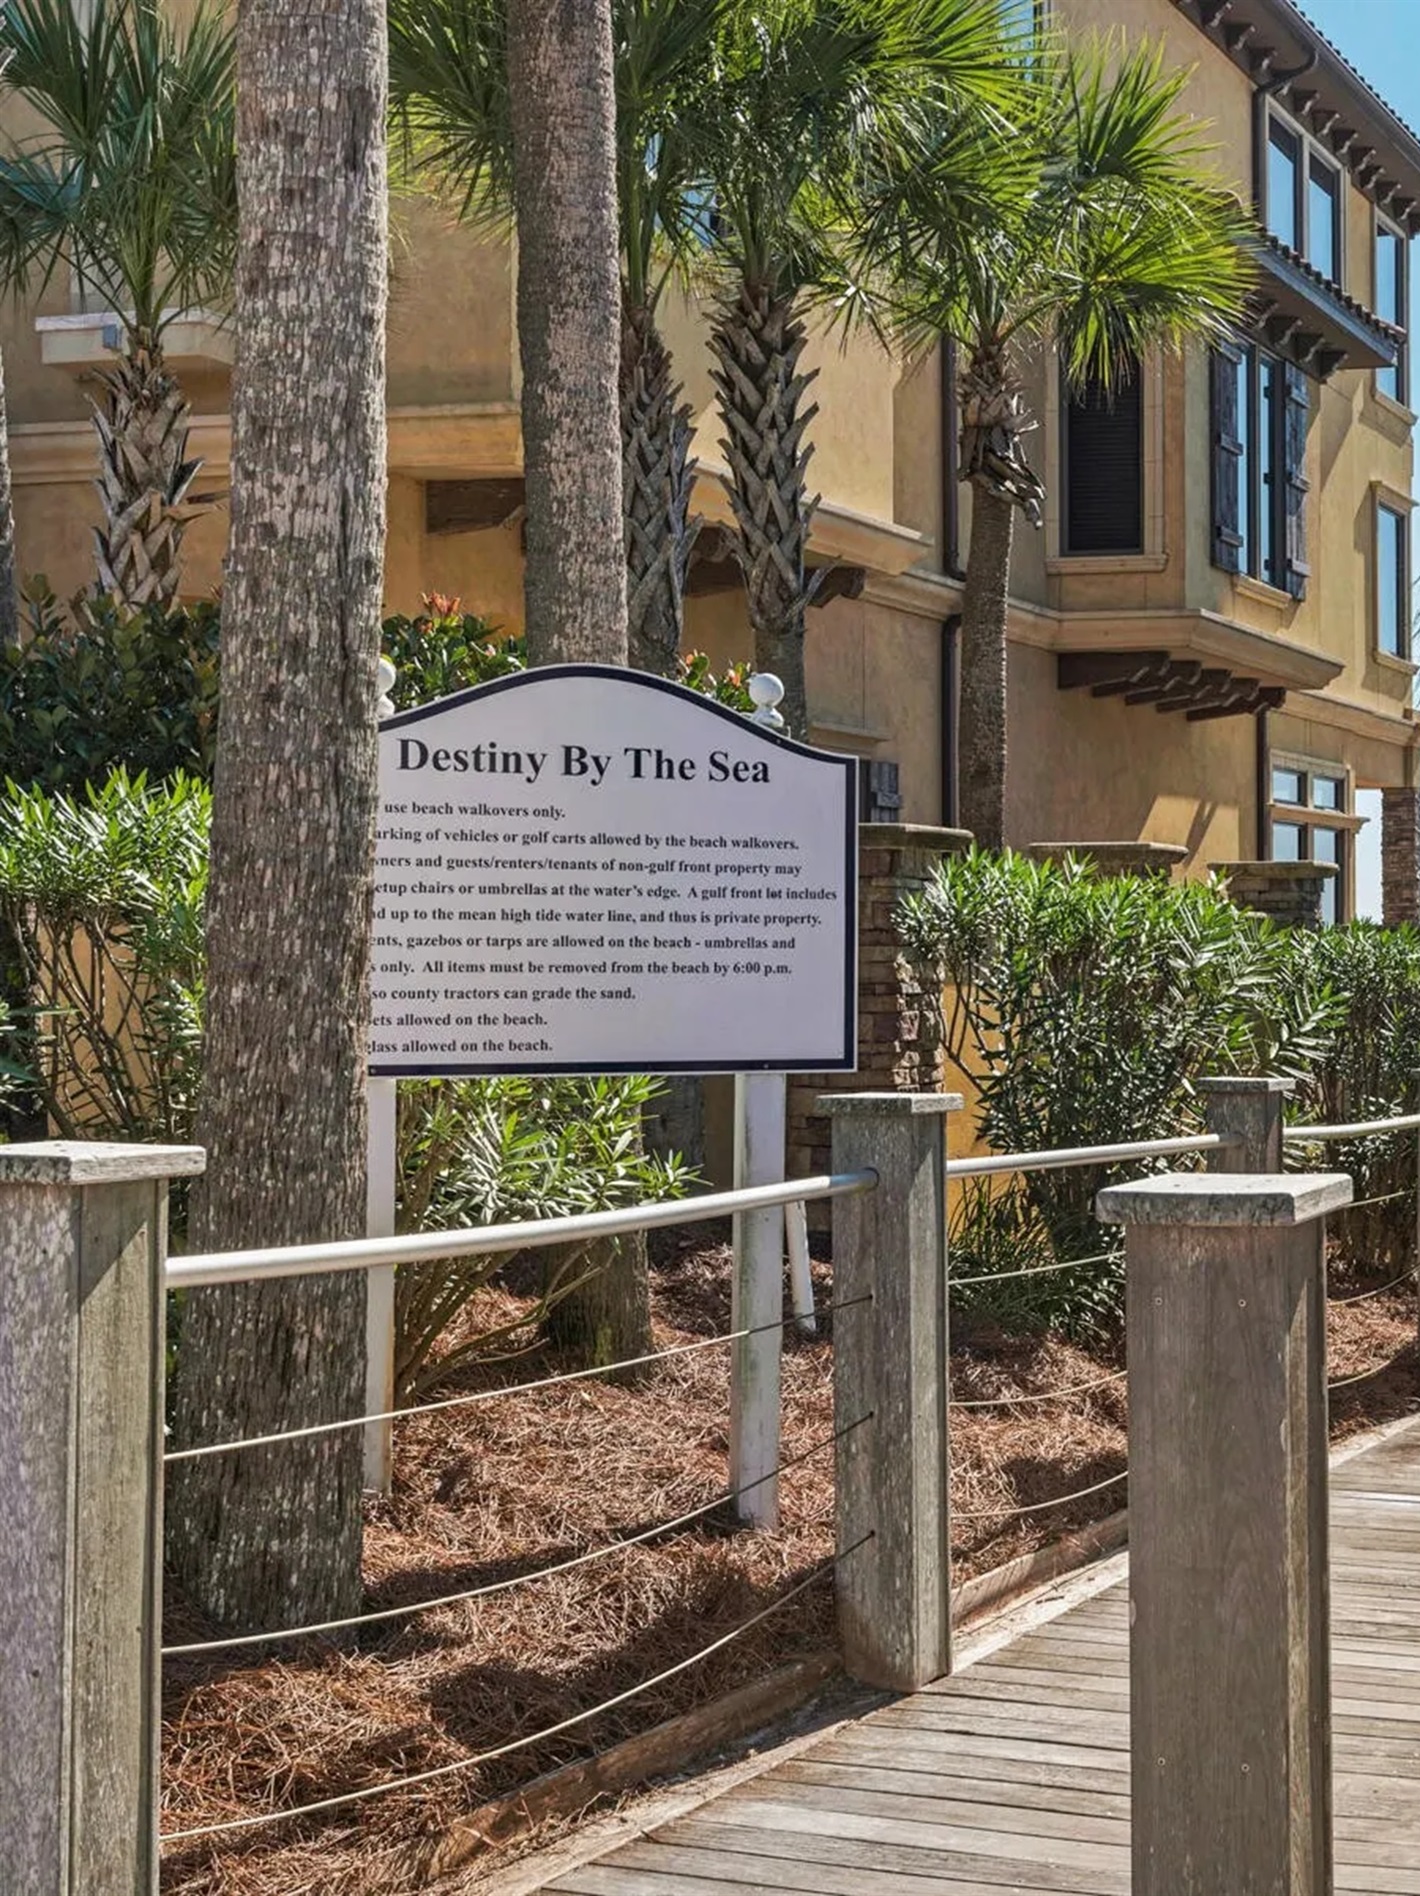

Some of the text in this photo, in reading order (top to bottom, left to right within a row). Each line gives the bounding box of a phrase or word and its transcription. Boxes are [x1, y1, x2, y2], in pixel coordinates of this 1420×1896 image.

[397, 739, 770, 786] Destiny By The Sea
[384, 800, 566, 822] use beach walkovers only.
[425, 827, 442, 842] of
[443, 828, 500, 844] vehicles
[502, 832, 520, 844] or
[521, 830, 551, 847] golf
[551, 833, 587, 845] carts
[589, 832, 642, 847] allowed
[644, 833, 663, 850] by
[664, 834, 687, 848] the
[689, 834, 728, 849] beach
[730, 836, 800, 851] walkovers.
[415, 854, 443, 868] and
[445, 855, 599, 872] guests/renters/tenants
[601, 857, 617, 872] of
[618, 859, 677, 876] non-gulf
[678, 859, 712, 874] front
[713, 863, 772, 878] property
[774, 865, 803, 878] may
[410, 880, 456, 895] chairs
[457, 884, 476, 896] or
[477, 882, 549, 896] umbrellas
[550, 884, 566, 897] at
[568, 883, 591, 897] the
[646, 885, 681, 901] edge.
[686, 885, 699, 899] A
[700, 885, 729, 902] gulf
[730, 886, 763, 900] front
[765, 886, 783, 900] lot
[785, 887, 838, 901] includes
[390, 909, 410, 924] up
[413, 908, 429, 921] to
[431, 907, 455, 921] the
[457, 910, 497, 922] mean
[500, 907, 532, 925] high
[535, 908, 563, 922] tide
[564, 910, 605, 923] water
[607, 909, 637, 925] line,
[639, 909, 665, 923] and
[668, 910, 698, 924] thus
[700, 910, 712, 924] is
[713, 910, 761, 927] private
[763, 913, 822, 929] property.
[405, 933, 463, 950] gazebos
[465, 936, 484, 948] or
[485, 935, 523, 951] tarps
[525, 937, 549, 948] are
[551, 934, 605, 948] allowed
[607, 937, 625, 949] on
[628, 935, 651, 949] the
[652, 935, 692, 950] beach
[703, 936, 769, 950] umbrellas
[771, 936, 796, 950] and
[379, 959, 415, 977] only.
[421, 959, 444, 974] All
[447, 959, 486, 974] items
[489, 961, 524, 974] must
[527, 960, 545, 974] be
[547, 960, 608, 975] removed
[610, 960, 644, 974] from
[647, 960, 669, 975] the
[671, 961, 710, 975] beach
[713, 961, 731, 978] by
[732, 961, 762, 975] 6:00
[763, 964, 793, 978] p.m.
[390, 987, 441, 1004] county
[443, 987, 500, 1000] tractors
[503, 989, 529, 1000] can
[531, 986, 572, 1003] grade
[575, 986, 598, 1000] the
[599, 986, 637, 1000] sand.
[396, 1012, 452, 1027] allowed
[454, 1015, 474, 1027] on
[476, 1012, 500, 1027] the
[502, 1012, 548, 1027] beach.
[401, 1039, 457, 1053] allowed
[460, 1042, 479, 1053] on
[482, 1038, 505, 1052] the
[508, 1038, 553, 1052] beach.
